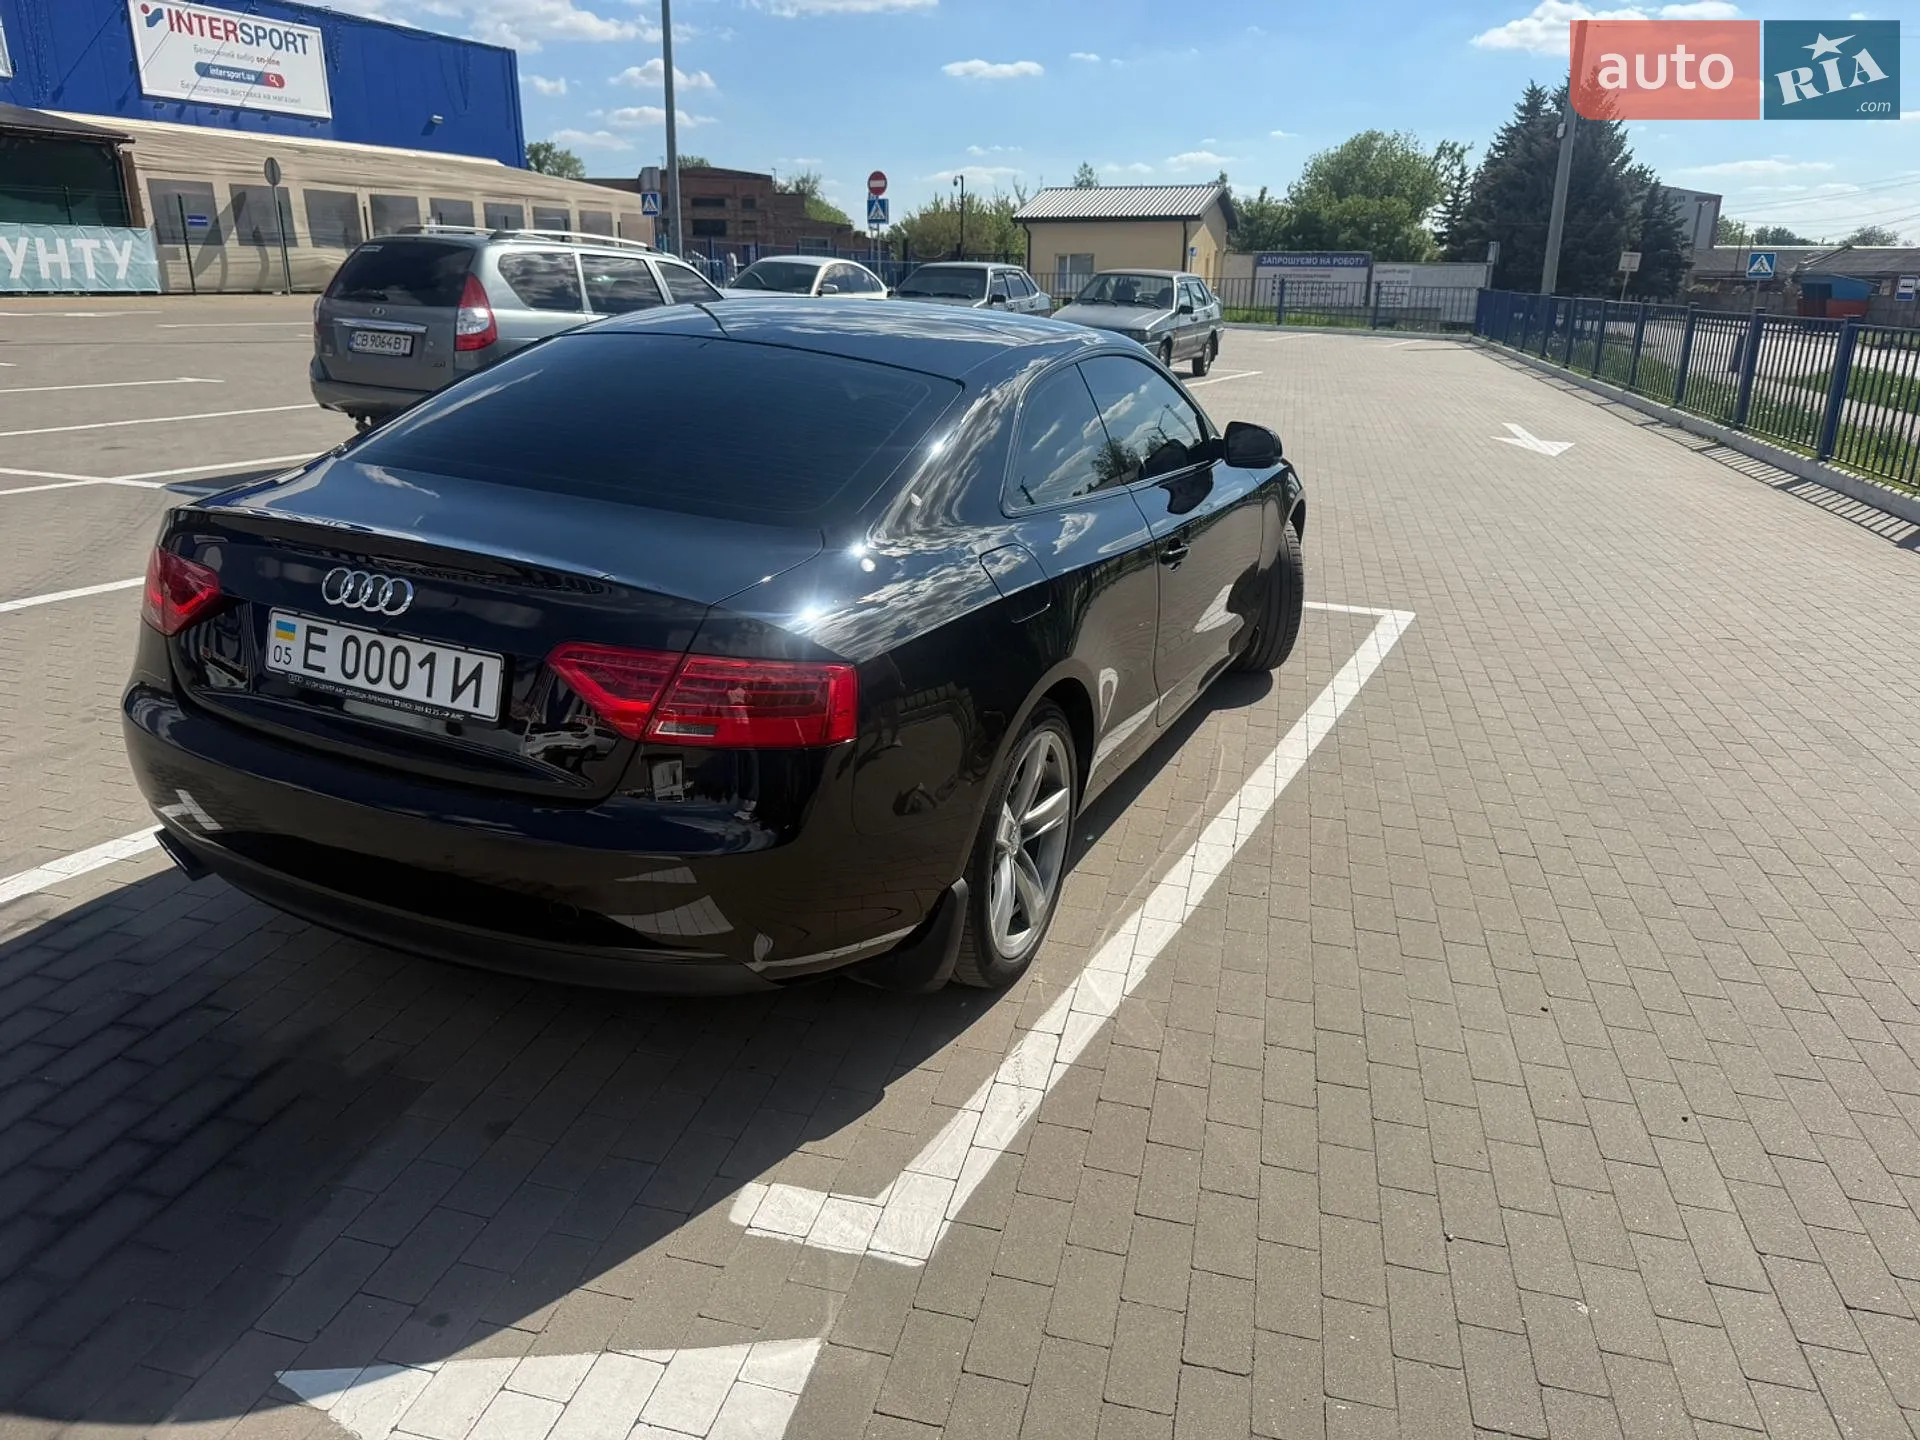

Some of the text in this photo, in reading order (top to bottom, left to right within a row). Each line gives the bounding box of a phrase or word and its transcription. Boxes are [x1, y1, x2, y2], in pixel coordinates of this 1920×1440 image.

[167, 8, 309, 55] INTERSPORT
[209, 65, 256, 81] intersport.ua
[0, 237, 133, 280] УНТУ
[1319, 256, 1331, 266] НА
[1332, 256, 1366, 266] РОБОТУ
[273, 644, 292, 666] 05
